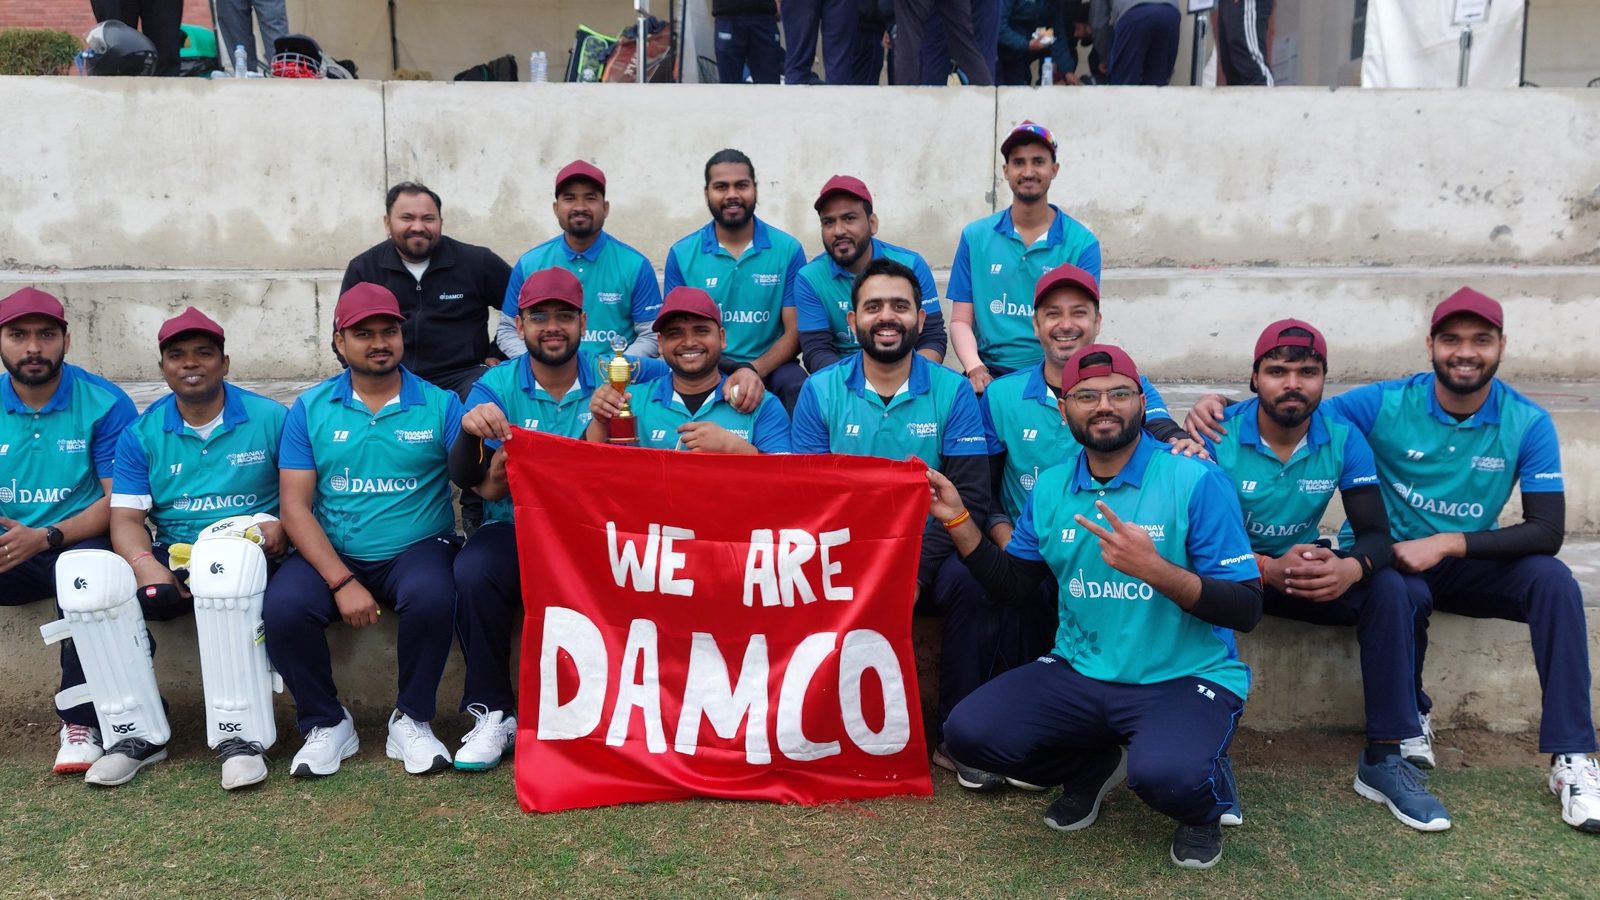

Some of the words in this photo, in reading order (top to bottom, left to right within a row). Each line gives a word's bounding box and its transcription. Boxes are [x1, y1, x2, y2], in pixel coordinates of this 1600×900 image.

[724, 310, 770, 323] DAMCO
[351, 477, 418, 492] DAMCO
[190, 494, 257, 511] DAMCO
[1411, 493, 1484, 518] DAMCO
[211, 521, 235, 533] DSC
[606, 521, 696, 597] WE
[743, 527, 854, 607] ARE
[1087, 581, 1153, 600] DAMCO
[537, 606, 910, 765] DAMCO
[112, 723, 136, 734] DSC
[219, 723, 242, 732] DSC
